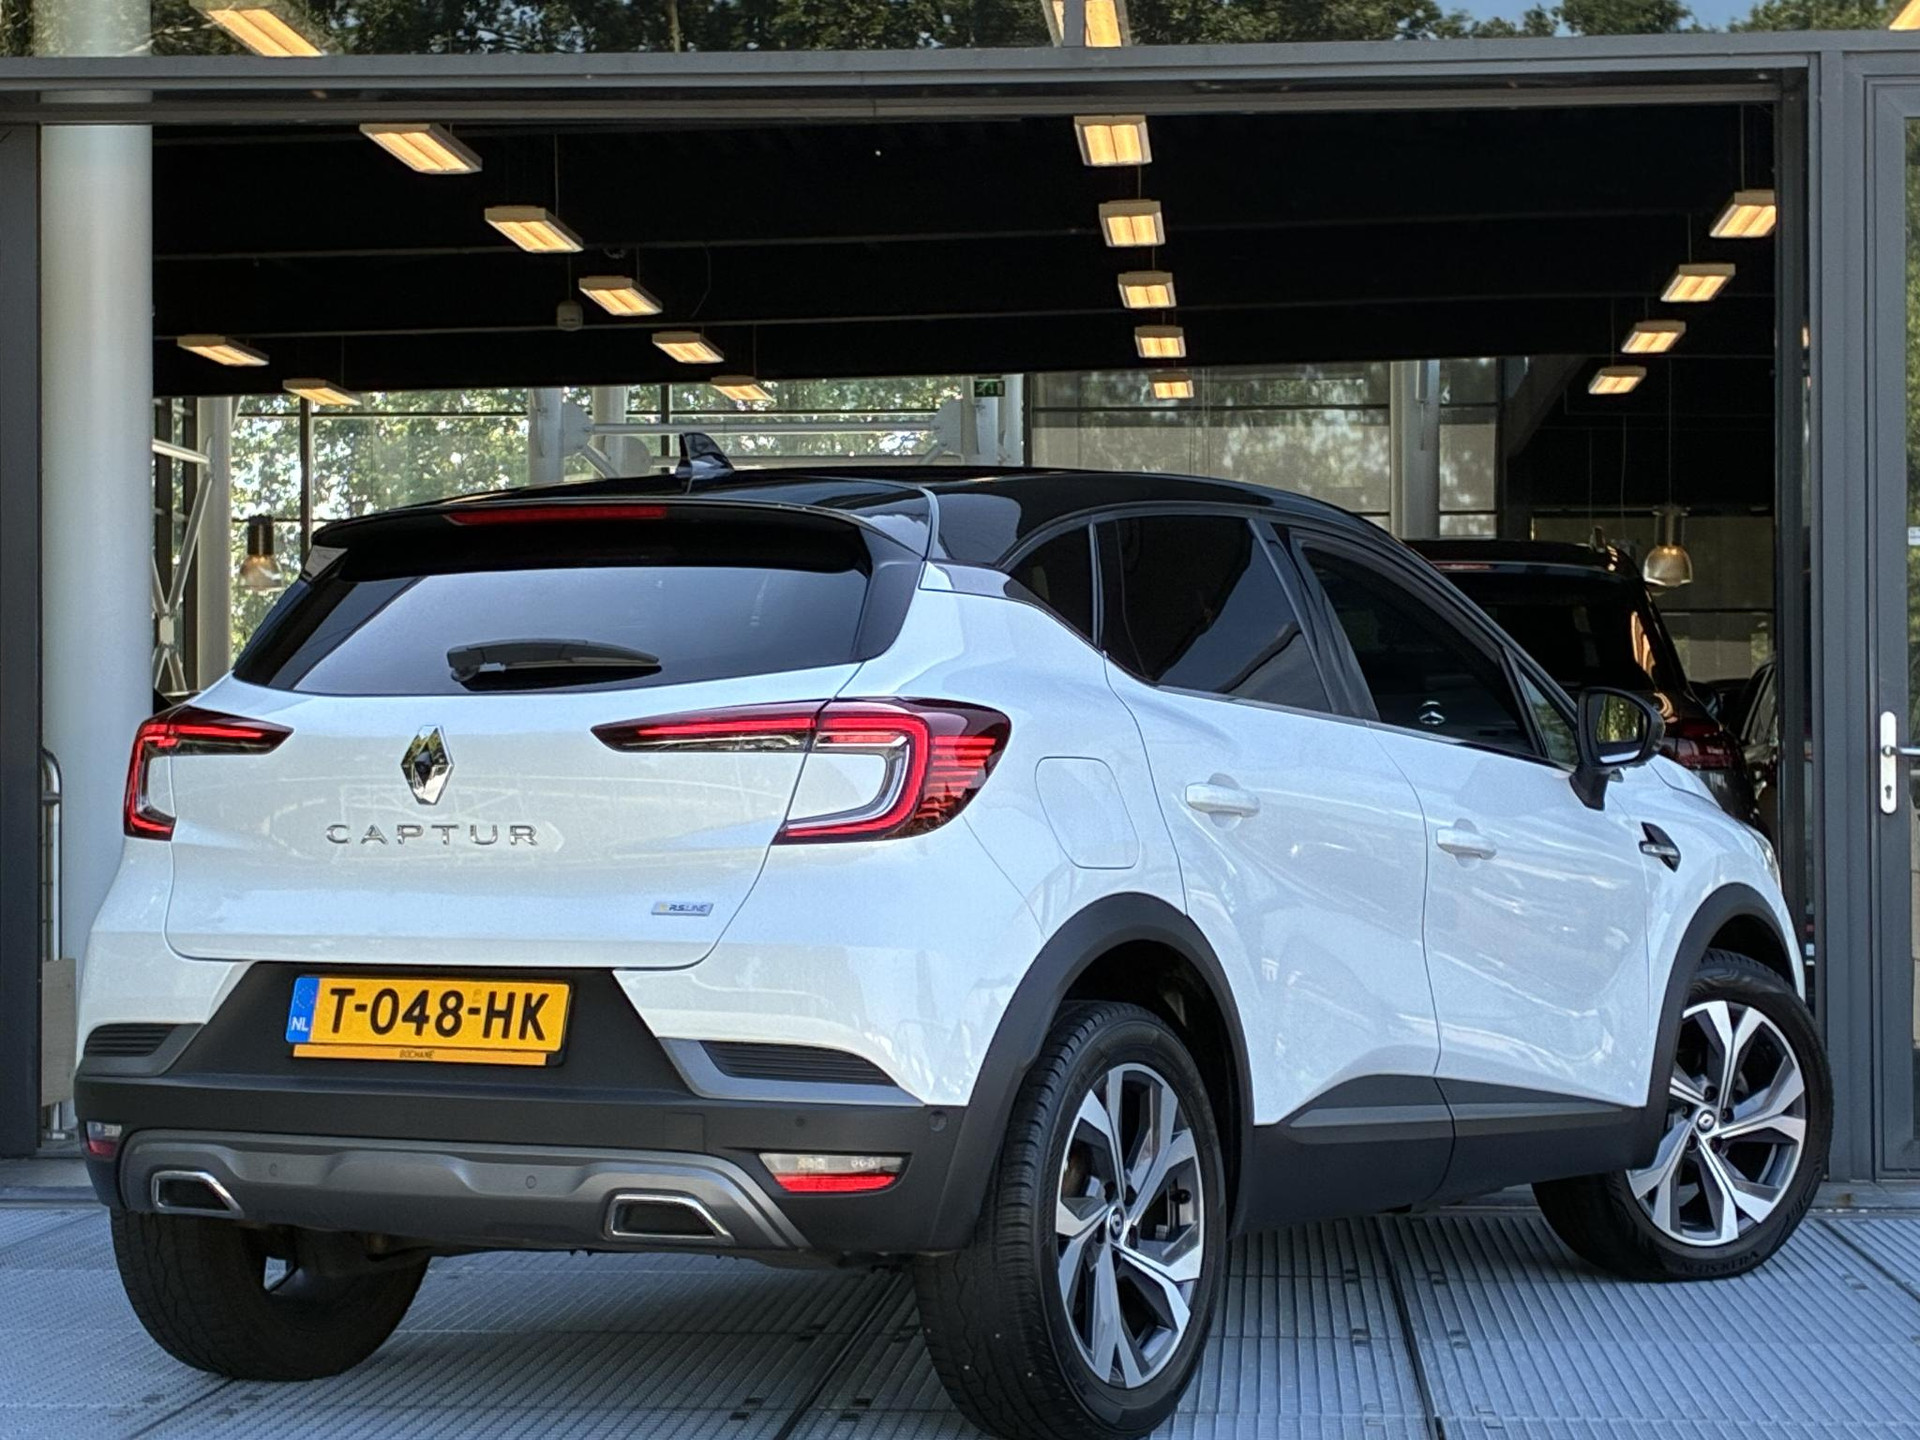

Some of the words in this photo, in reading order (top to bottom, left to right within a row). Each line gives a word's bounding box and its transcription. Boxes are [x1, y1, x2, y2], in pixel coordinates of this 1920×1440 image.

[326, 824, 538, 846] CAPTUR
[291, 1017, 309, 1032] NL
[329, 987, 550, 1041] T-048-HK
